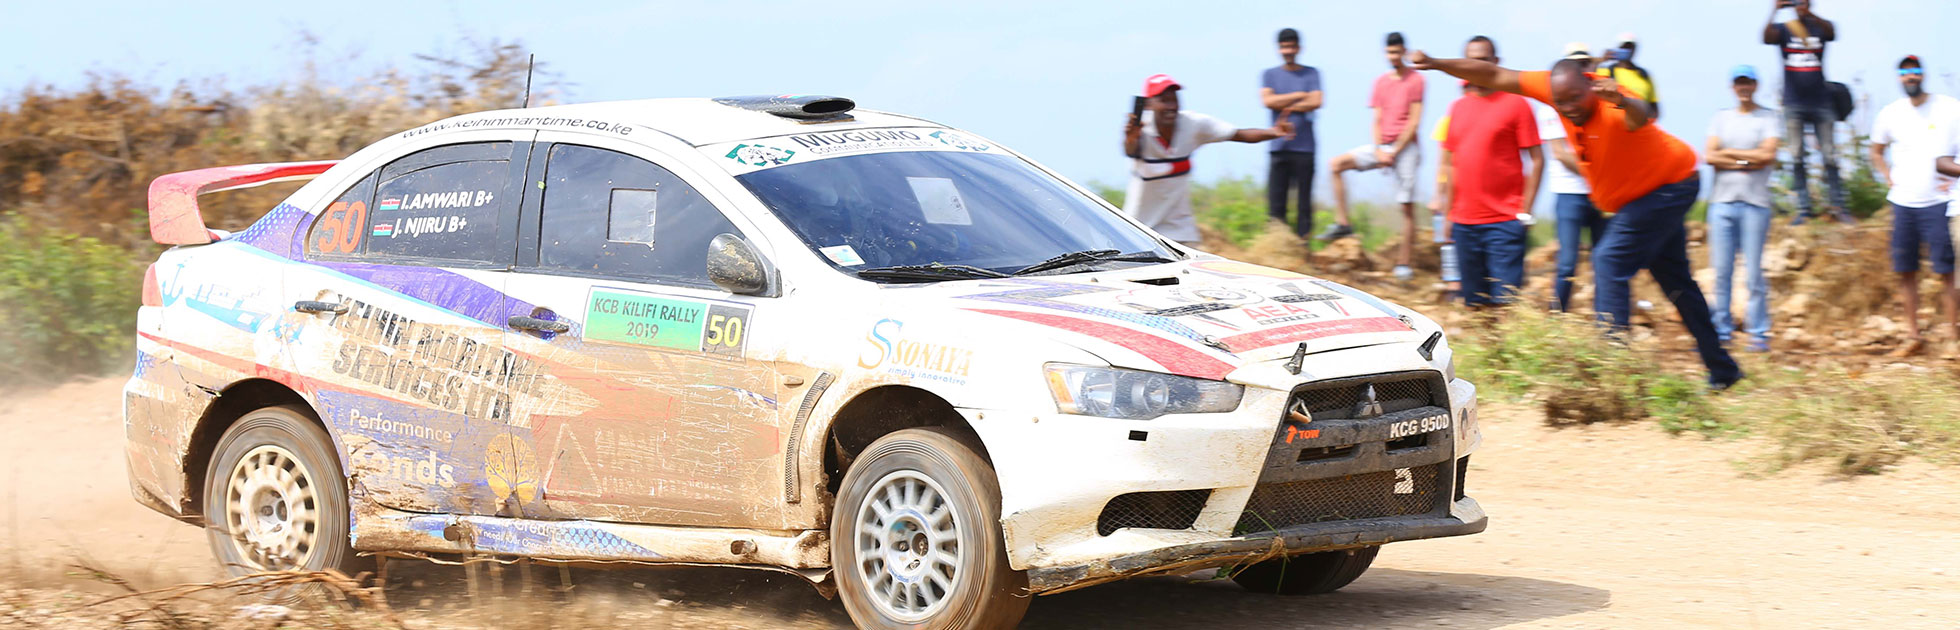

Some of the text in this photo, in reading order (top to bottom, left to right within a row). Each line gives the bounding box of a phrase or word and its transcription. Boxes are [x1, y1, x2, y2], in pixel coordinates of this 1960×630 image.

[790, 130, 921, 149] MUGUMO
[474, 190, 494, 205] B+
[318, 200, 367, 253] 50
[392, 215, 467, 239] J. NJIRU B+
[594, 298, 700, 324] KCB KILIFI RALLY
[1243, 303, 1311, 320] AEA
[625, 321, 659, 339] 2019
[707, 314, 743, 348] 50
[350, 408, 453, 444] Performance
[1298, 429, 1320, 439] TOW
[1389, 413, 1450, 439] KCG 950D
